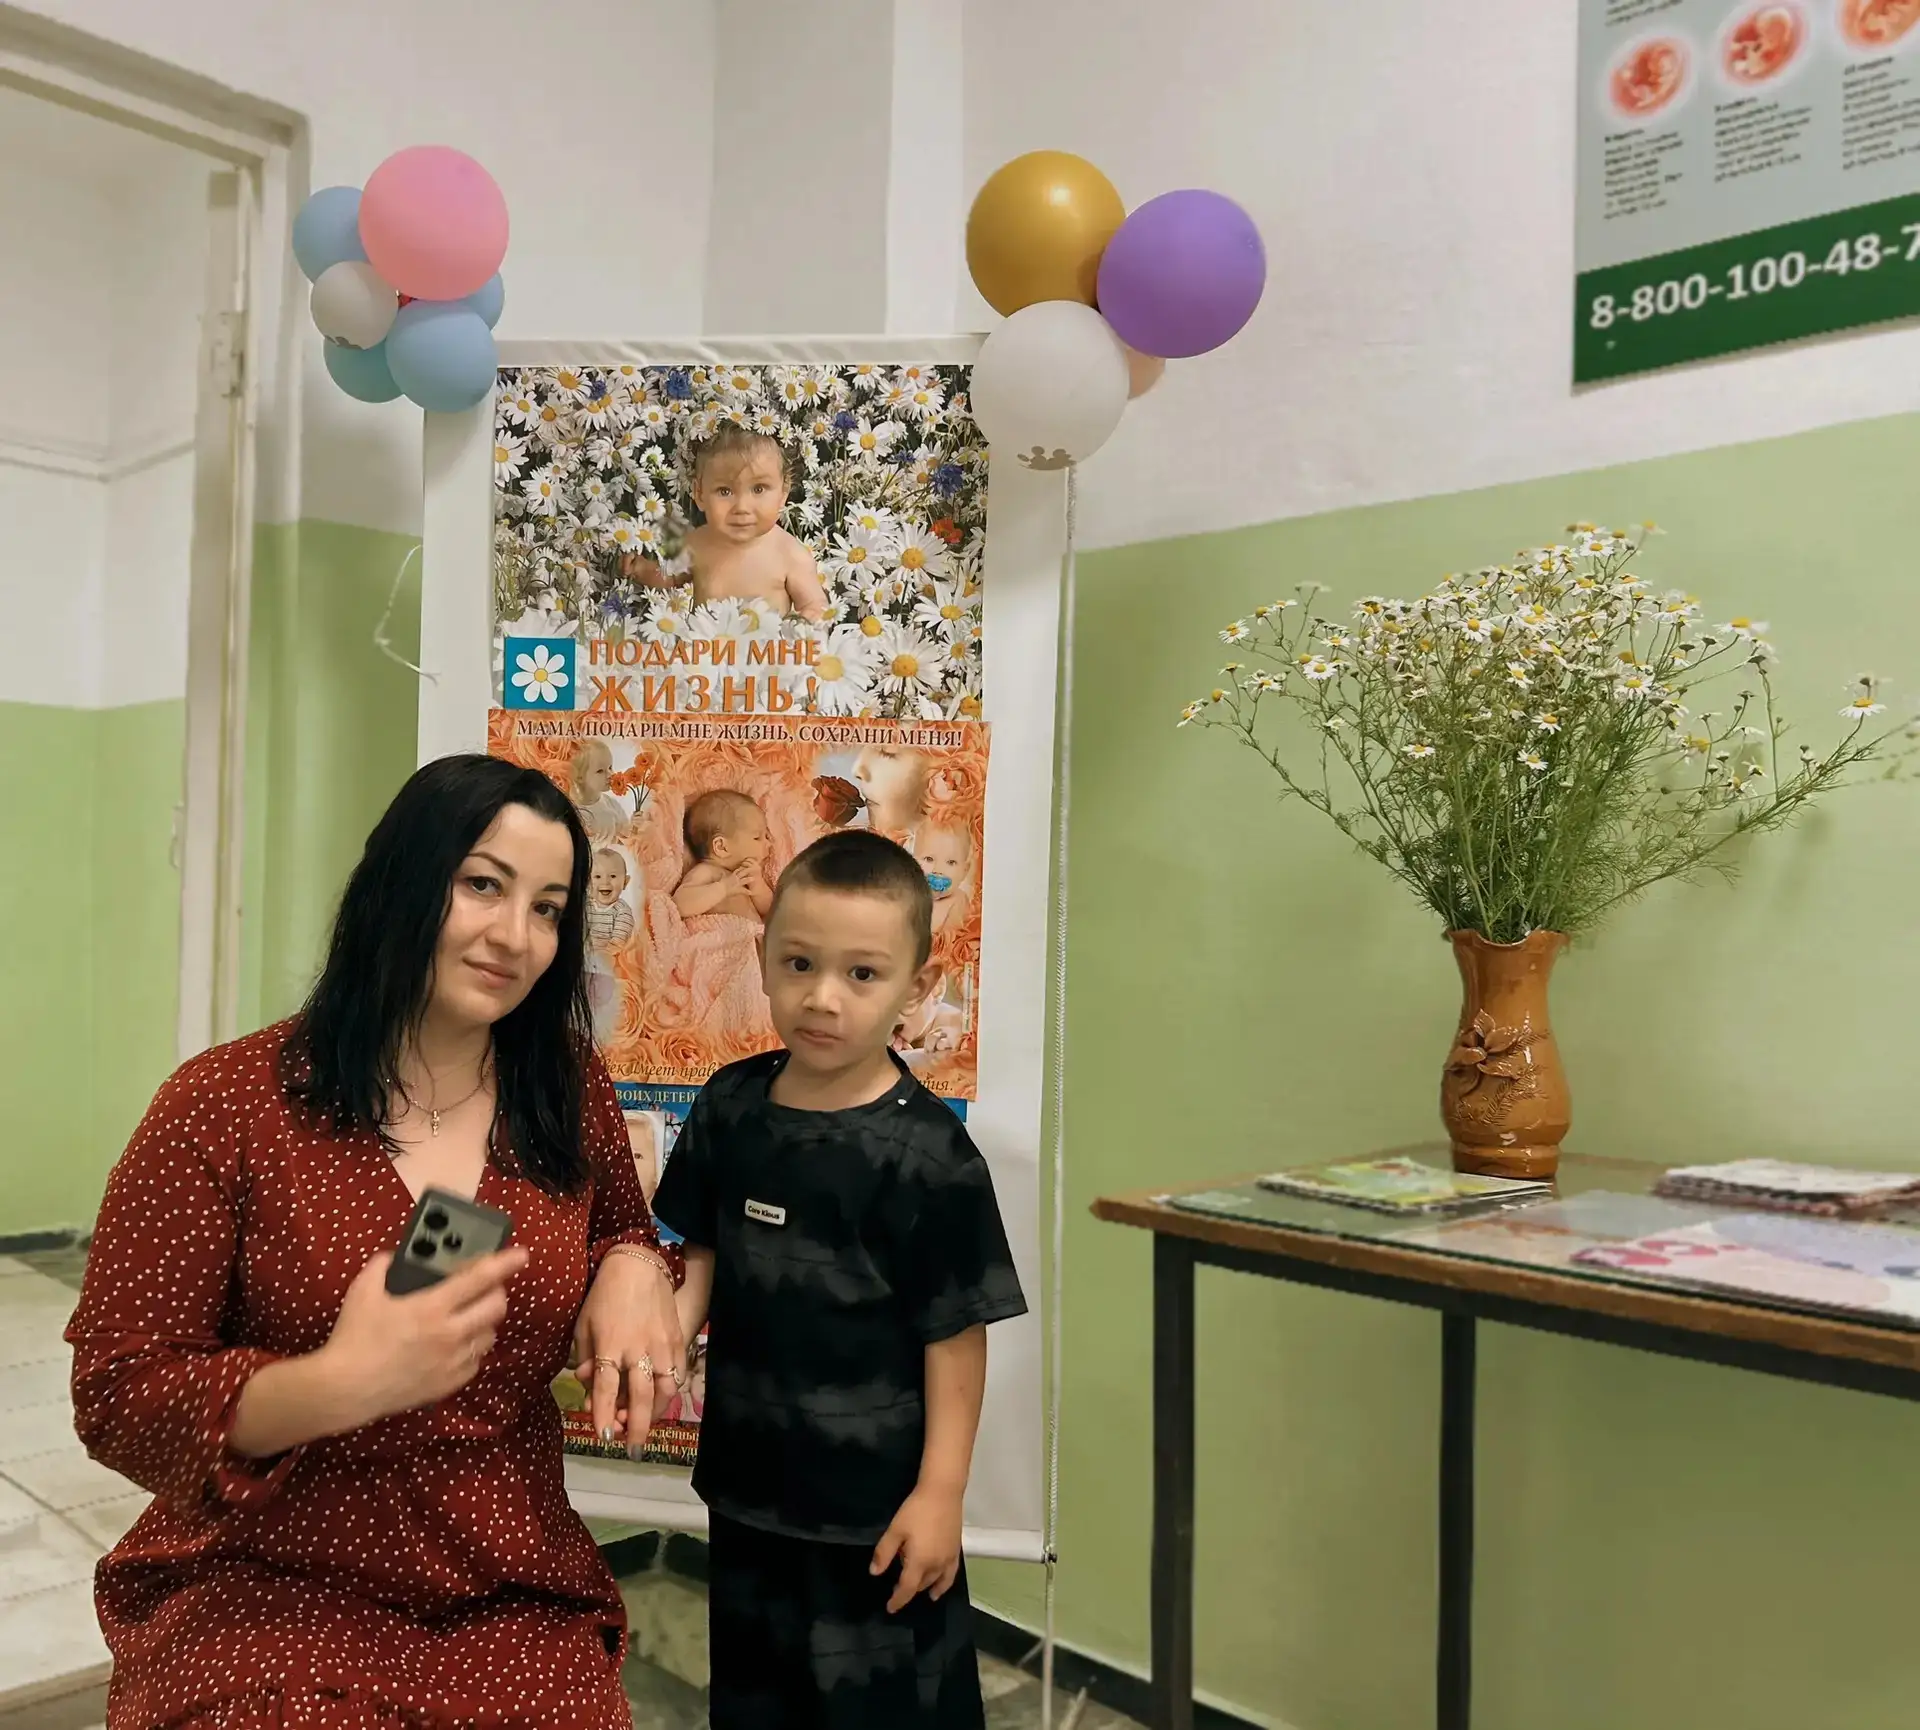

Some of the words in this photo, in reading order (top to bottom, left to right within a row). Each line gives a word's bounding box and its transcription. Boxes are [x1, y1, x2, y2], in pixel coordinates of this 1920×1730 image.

[1590, 222, 1920, 329] 8-800-100-48-7
[589, 638, 737, 668] ПОДАРИ
[746, 639, 821, 667] МНЕ
[517, 720, 581, 739] МАМА,
[585, 722, 665, 740] ПОДАРИ
[669, 723, 713, 740] МНЕ
[717, 724, 794, 743] ЖИЗНЬ,
[799, 727, 894, 745] СОХРАНИ
[899, 729, 963, 747] МЕНЯ!
[653, 1089, 697, 1104] ДЕТЕЙ
